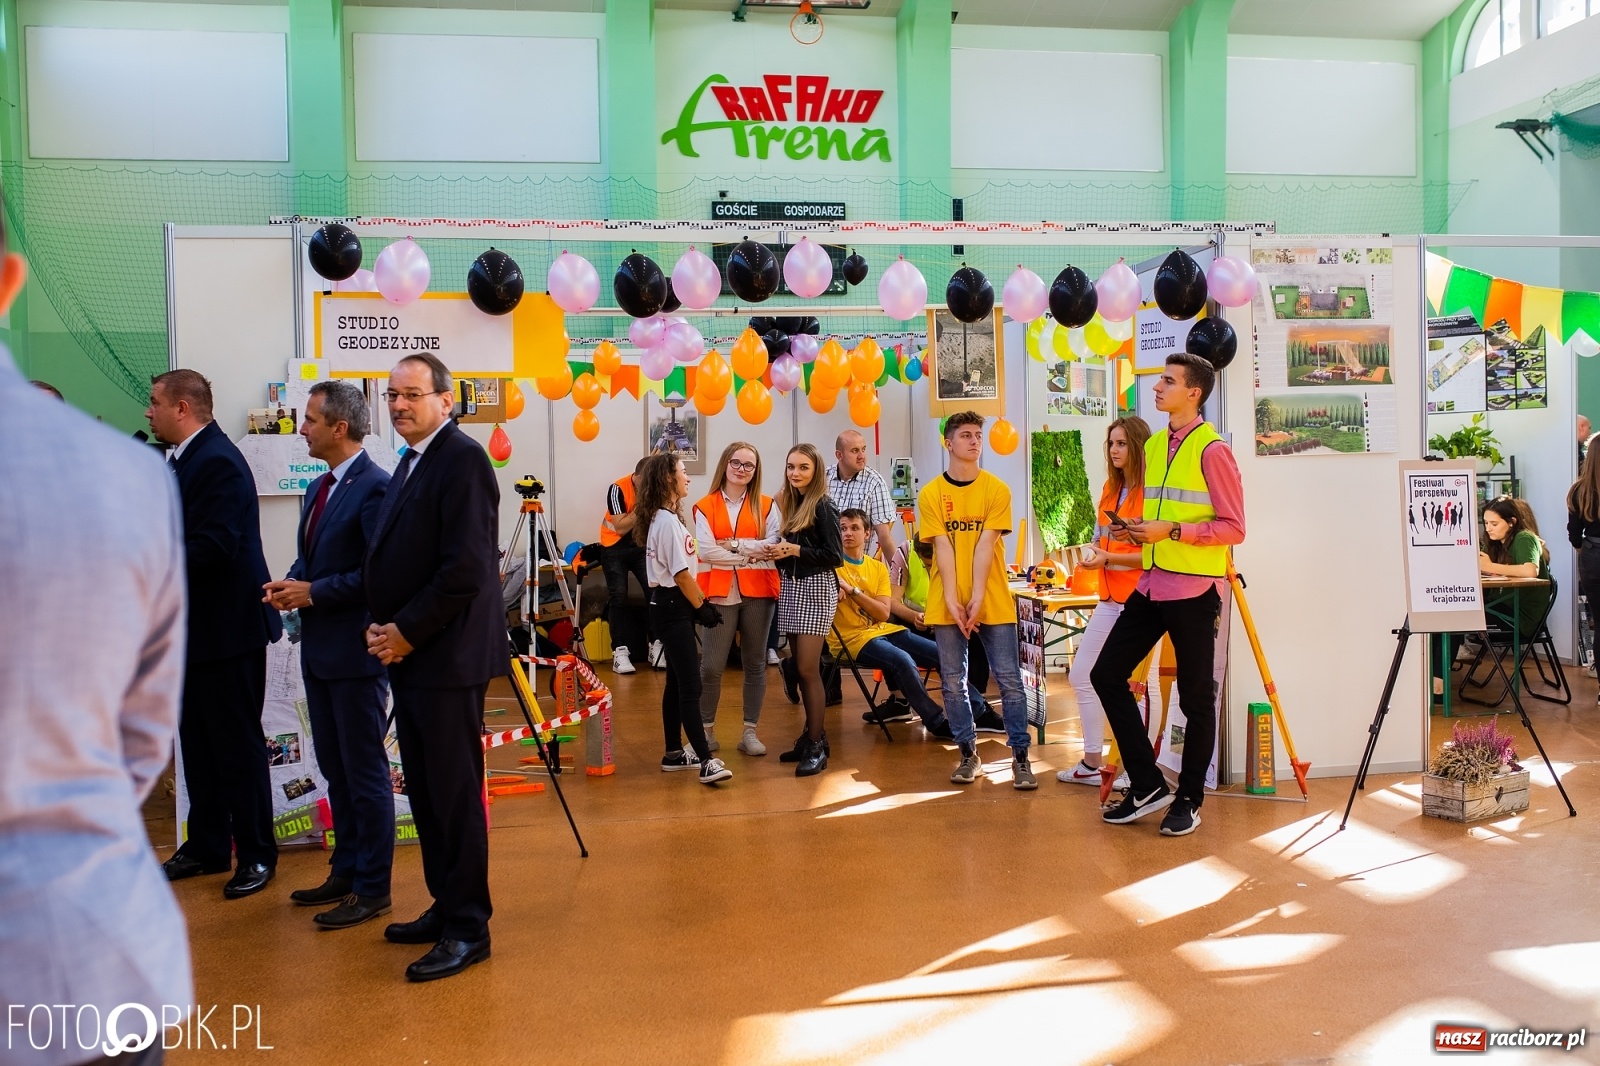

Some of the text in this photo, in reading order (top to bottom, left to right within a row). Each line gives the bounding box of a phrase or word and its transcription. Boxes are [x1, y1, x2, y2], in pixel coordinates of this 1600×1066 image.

[711, 75, 884, 123] RAFAKO
[661, 74, 892, 162] Arena
[716, 202, 844, 217] GOŚCIE GOSPODARZE
[338, 316, 399, 330] STUDIO
[1141, 321, 1162, 335] STUDIO
[338, 336, 440, 350] GEODEZYJNE
[1141, 336, 1175, 351] GEODEZYJNE
[289, 464, 328, 473] TECHNI
[1414, 479, 1444, 488] Festiwal
[1415, 489, 1458, 498] perspektyw
[945, 520, 983, 532] EODET
[1425, 585, 1475, 594] architektura
[1432, 595, 1476, 604] krajobrazu
[275, 815, 314, 839] UDIO
